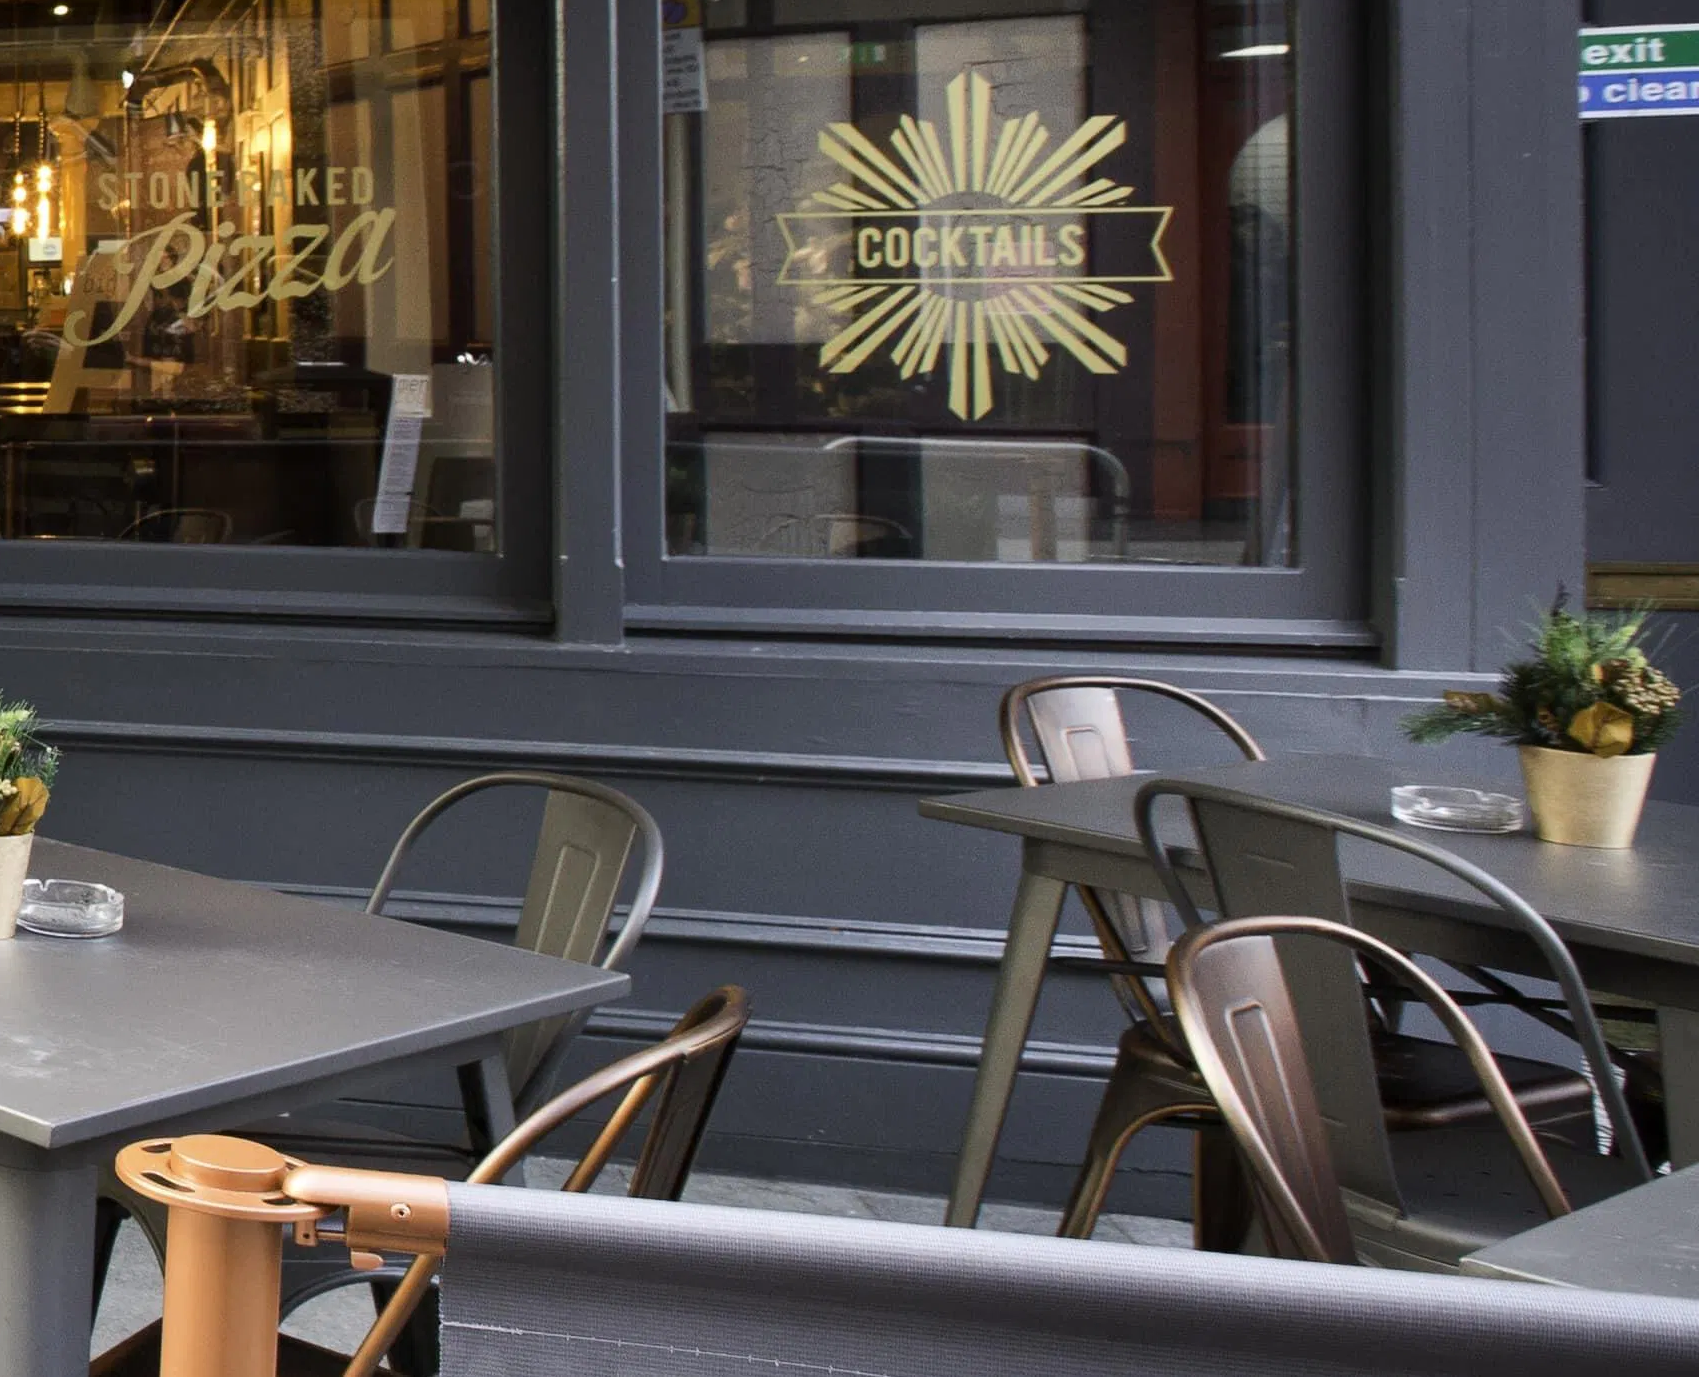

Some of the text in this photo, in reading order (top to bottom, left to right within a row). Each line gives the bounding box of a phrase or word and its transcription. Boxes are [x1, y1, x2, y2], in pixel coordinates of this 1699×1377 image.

[1583, 37, 1666, 65] exit
[857, 224, 1087, 269] COCKTAILS
[63, 207, 397, 348] Pizza
